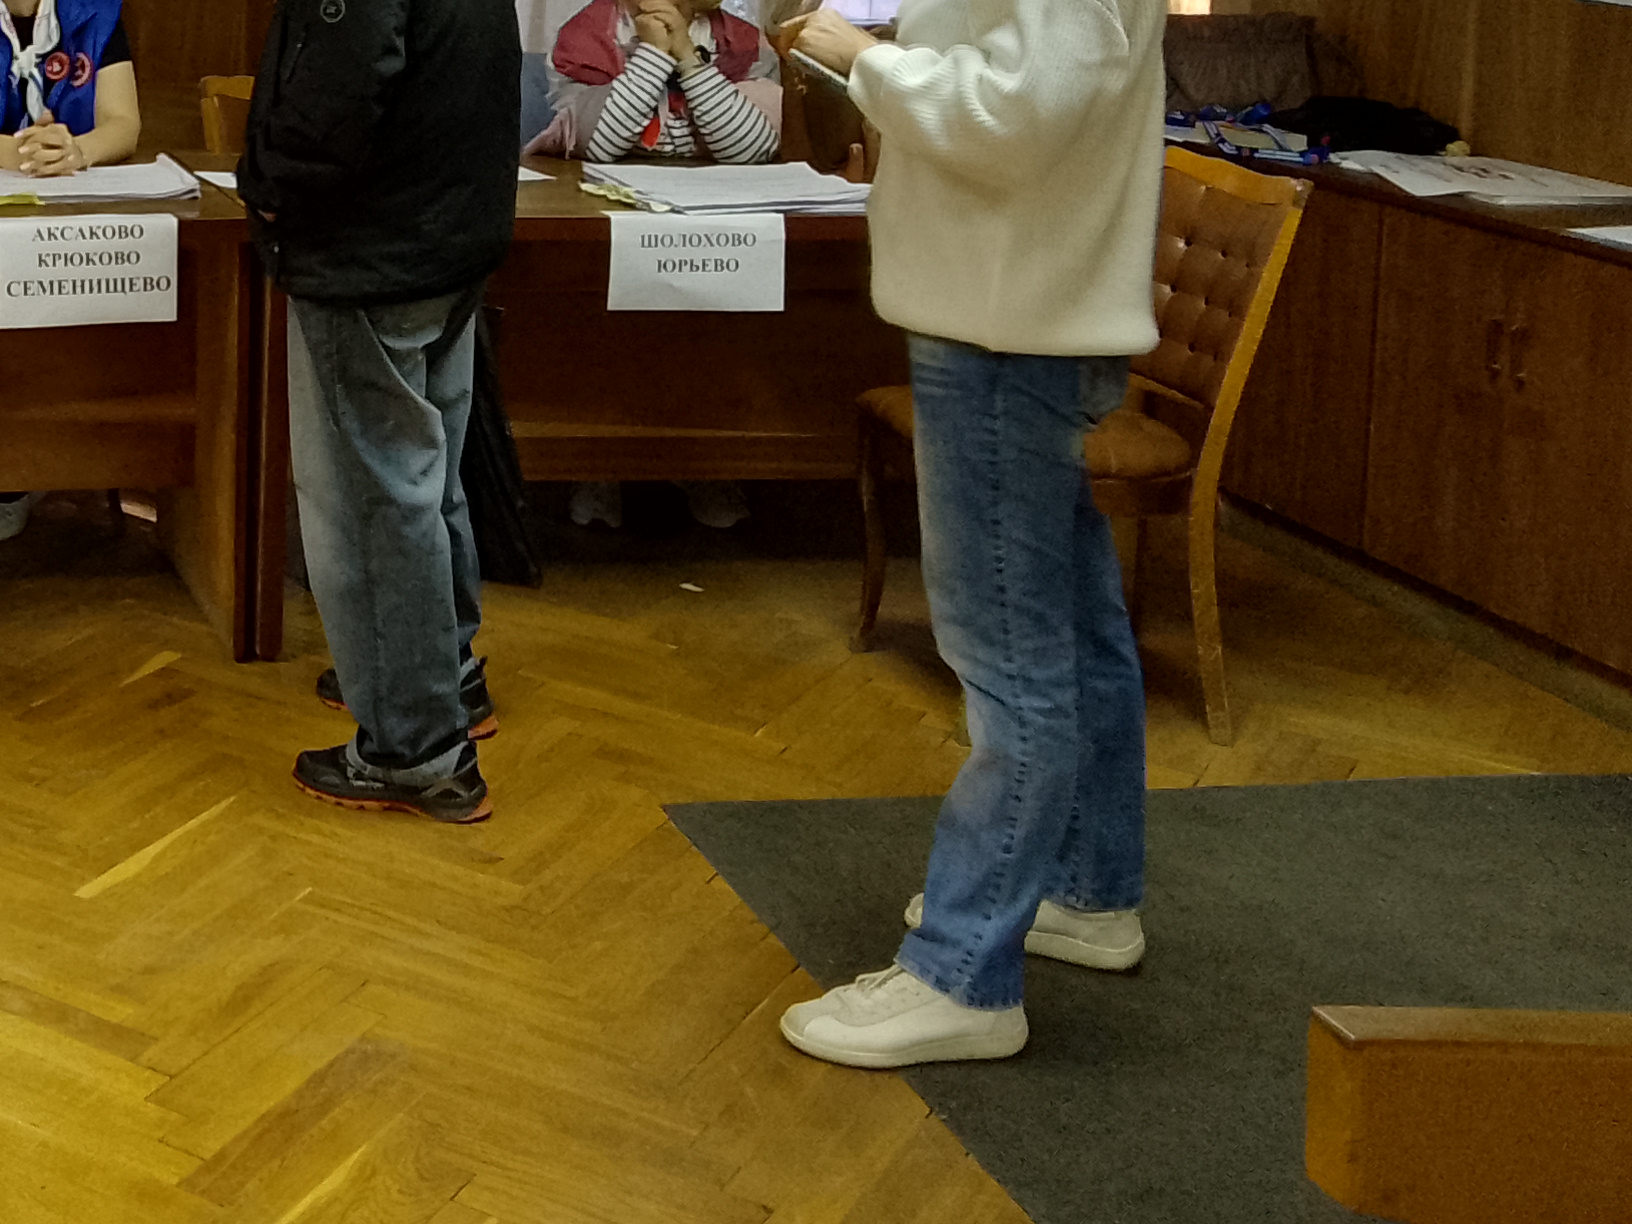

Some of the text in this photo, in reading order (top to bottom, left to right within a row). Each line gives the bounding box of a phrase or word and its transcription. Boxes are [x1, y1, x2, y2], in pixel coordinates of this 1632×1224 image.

[32, 224, 144, 242] АКСАКОВО
[640, 232, 757, 249] ШОЛОХОВО
[37, 250, 141, 268] КРЮКОВО
[656, 258, 740, 273] ЮРЬЕВО
[6, 275, 172, 297] СЕМЕНИЩЕВО
